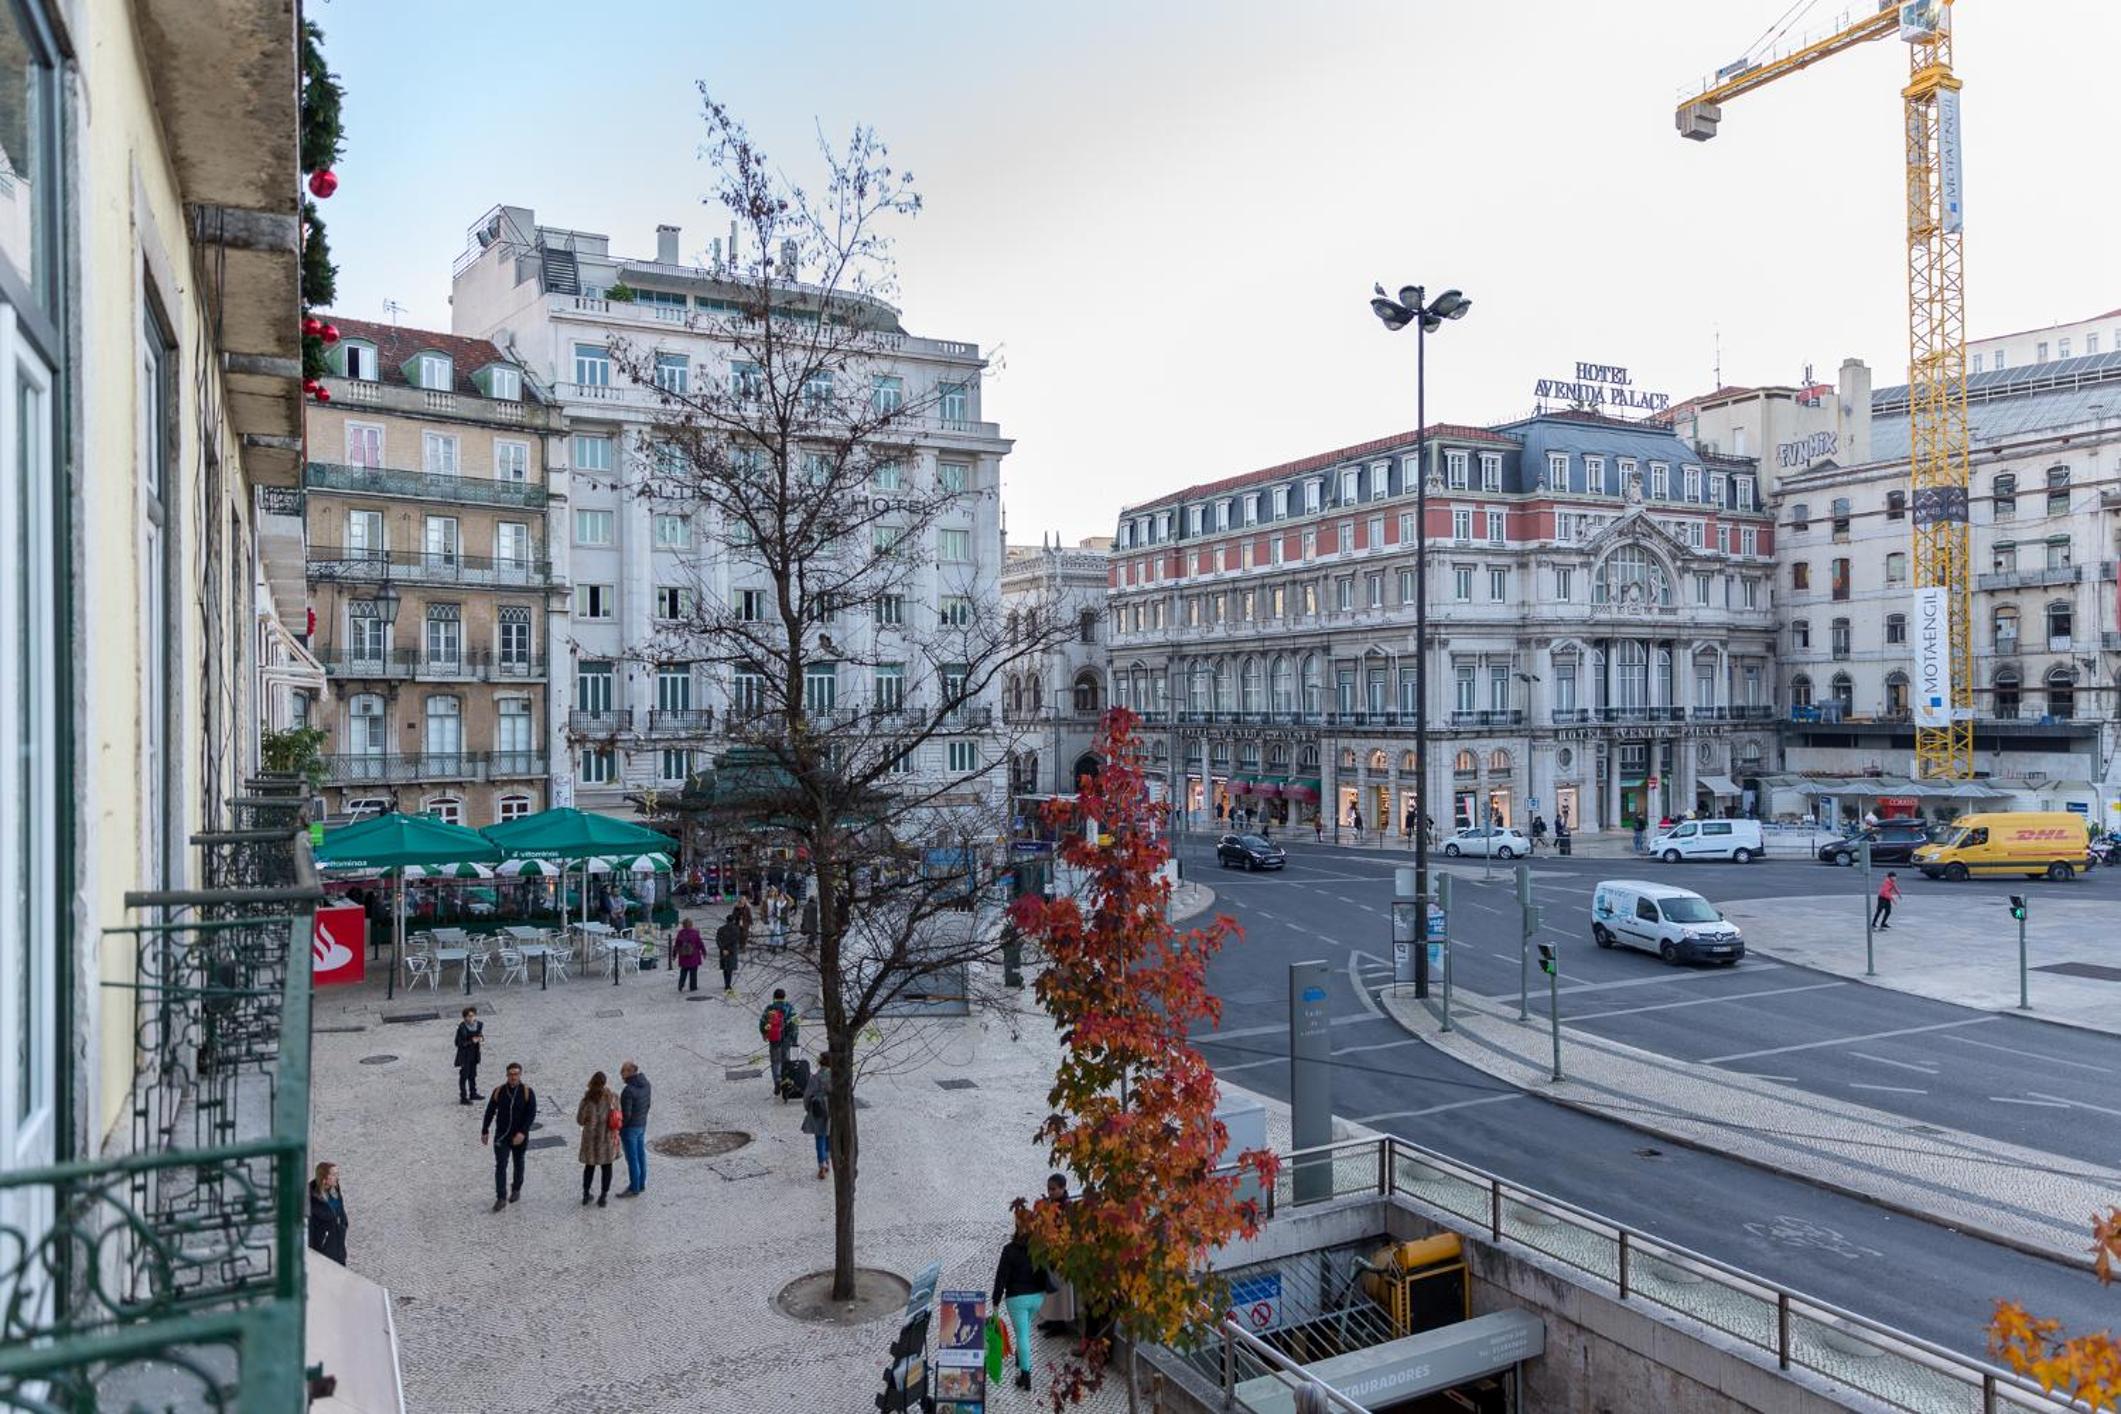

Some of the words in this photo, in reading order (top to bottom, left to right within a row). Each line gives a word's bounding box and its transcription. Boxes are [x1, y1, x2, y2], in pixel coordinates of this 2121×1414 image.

[1575, 361, 1632, 386] HOTEL
[1534, 378, 1607, 405] AVENIDA
[1609, 387, 1670, 411] PALACE
[1559, 729, 1605, 741] HOTEL
[1613, 727, 1673, 739] AVENIDA
[2015, 828, 2068, 840] DHL
